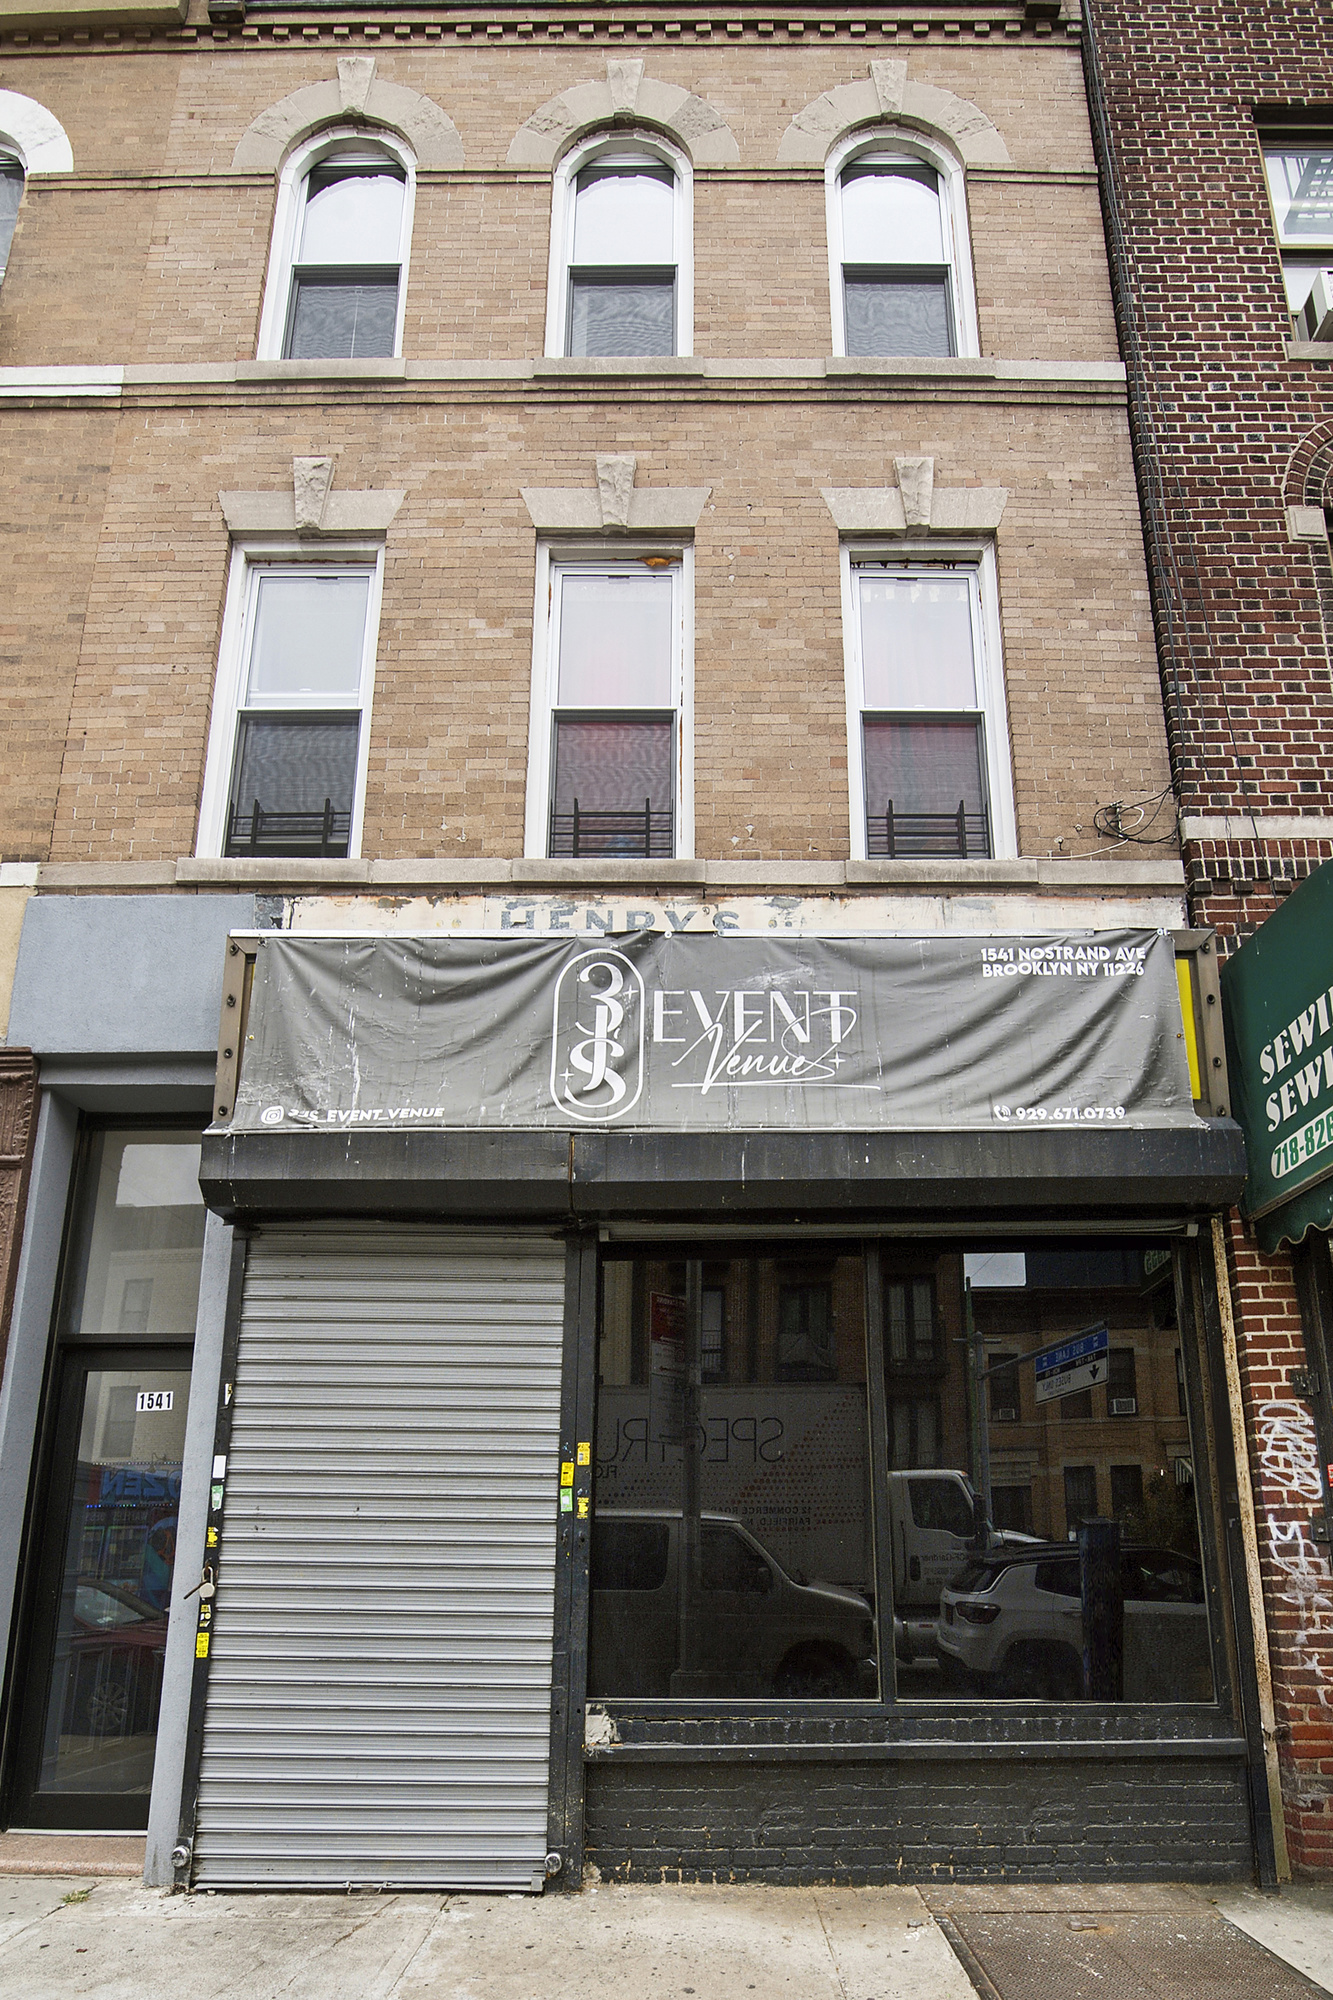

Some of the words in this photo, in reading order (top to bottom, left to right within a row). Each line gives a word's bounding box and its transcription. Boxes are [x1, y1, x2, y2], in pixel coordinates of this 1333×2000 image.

[980, 947, 1014, 962] 1541
[1018, 946, 1111, 962] NOSTRAND
[1114, 947, 1146, 961] AVE
[982, 962, 1073, 977] BROOKLYN
[1076, 962, 1099, 976] NY
[1102, 962, 1145, 977] 11226
[653, 990, 858, 1043] EVENT
[1260, 986, 1333, 1084] SEWI
[1015, 1106, 1126, 1121] 929.671.0739
[139, 1392, 172, 1410] 1541
